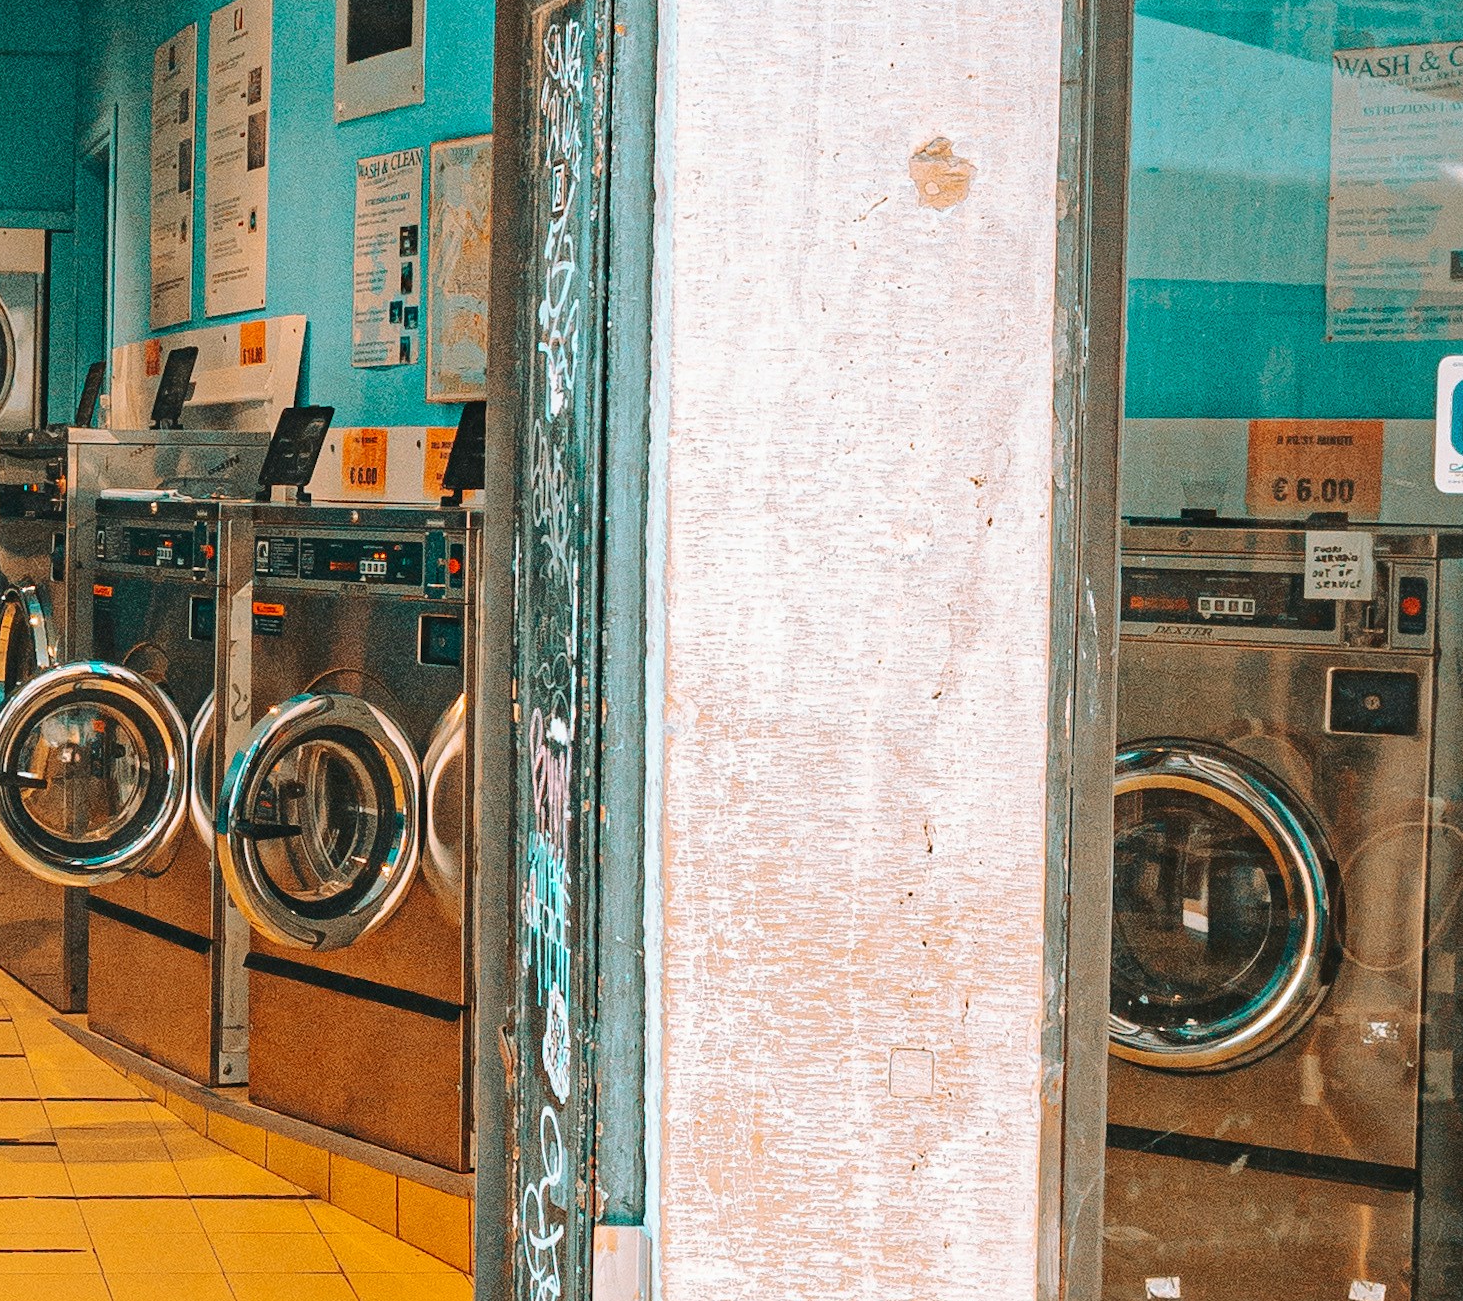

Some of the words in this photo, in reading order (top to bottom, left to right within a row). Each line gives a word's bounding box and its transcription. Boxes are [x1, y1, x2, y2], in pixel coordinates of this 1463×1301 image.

[1336, 55, 1410, 78] WASH
[391, 148, 423, 171] CLEAN
[1272, 477, 1289, 502] €
[1296, 477, 1355, 504] 6.00
[1153, 625, 1214, 637] DEXTER
